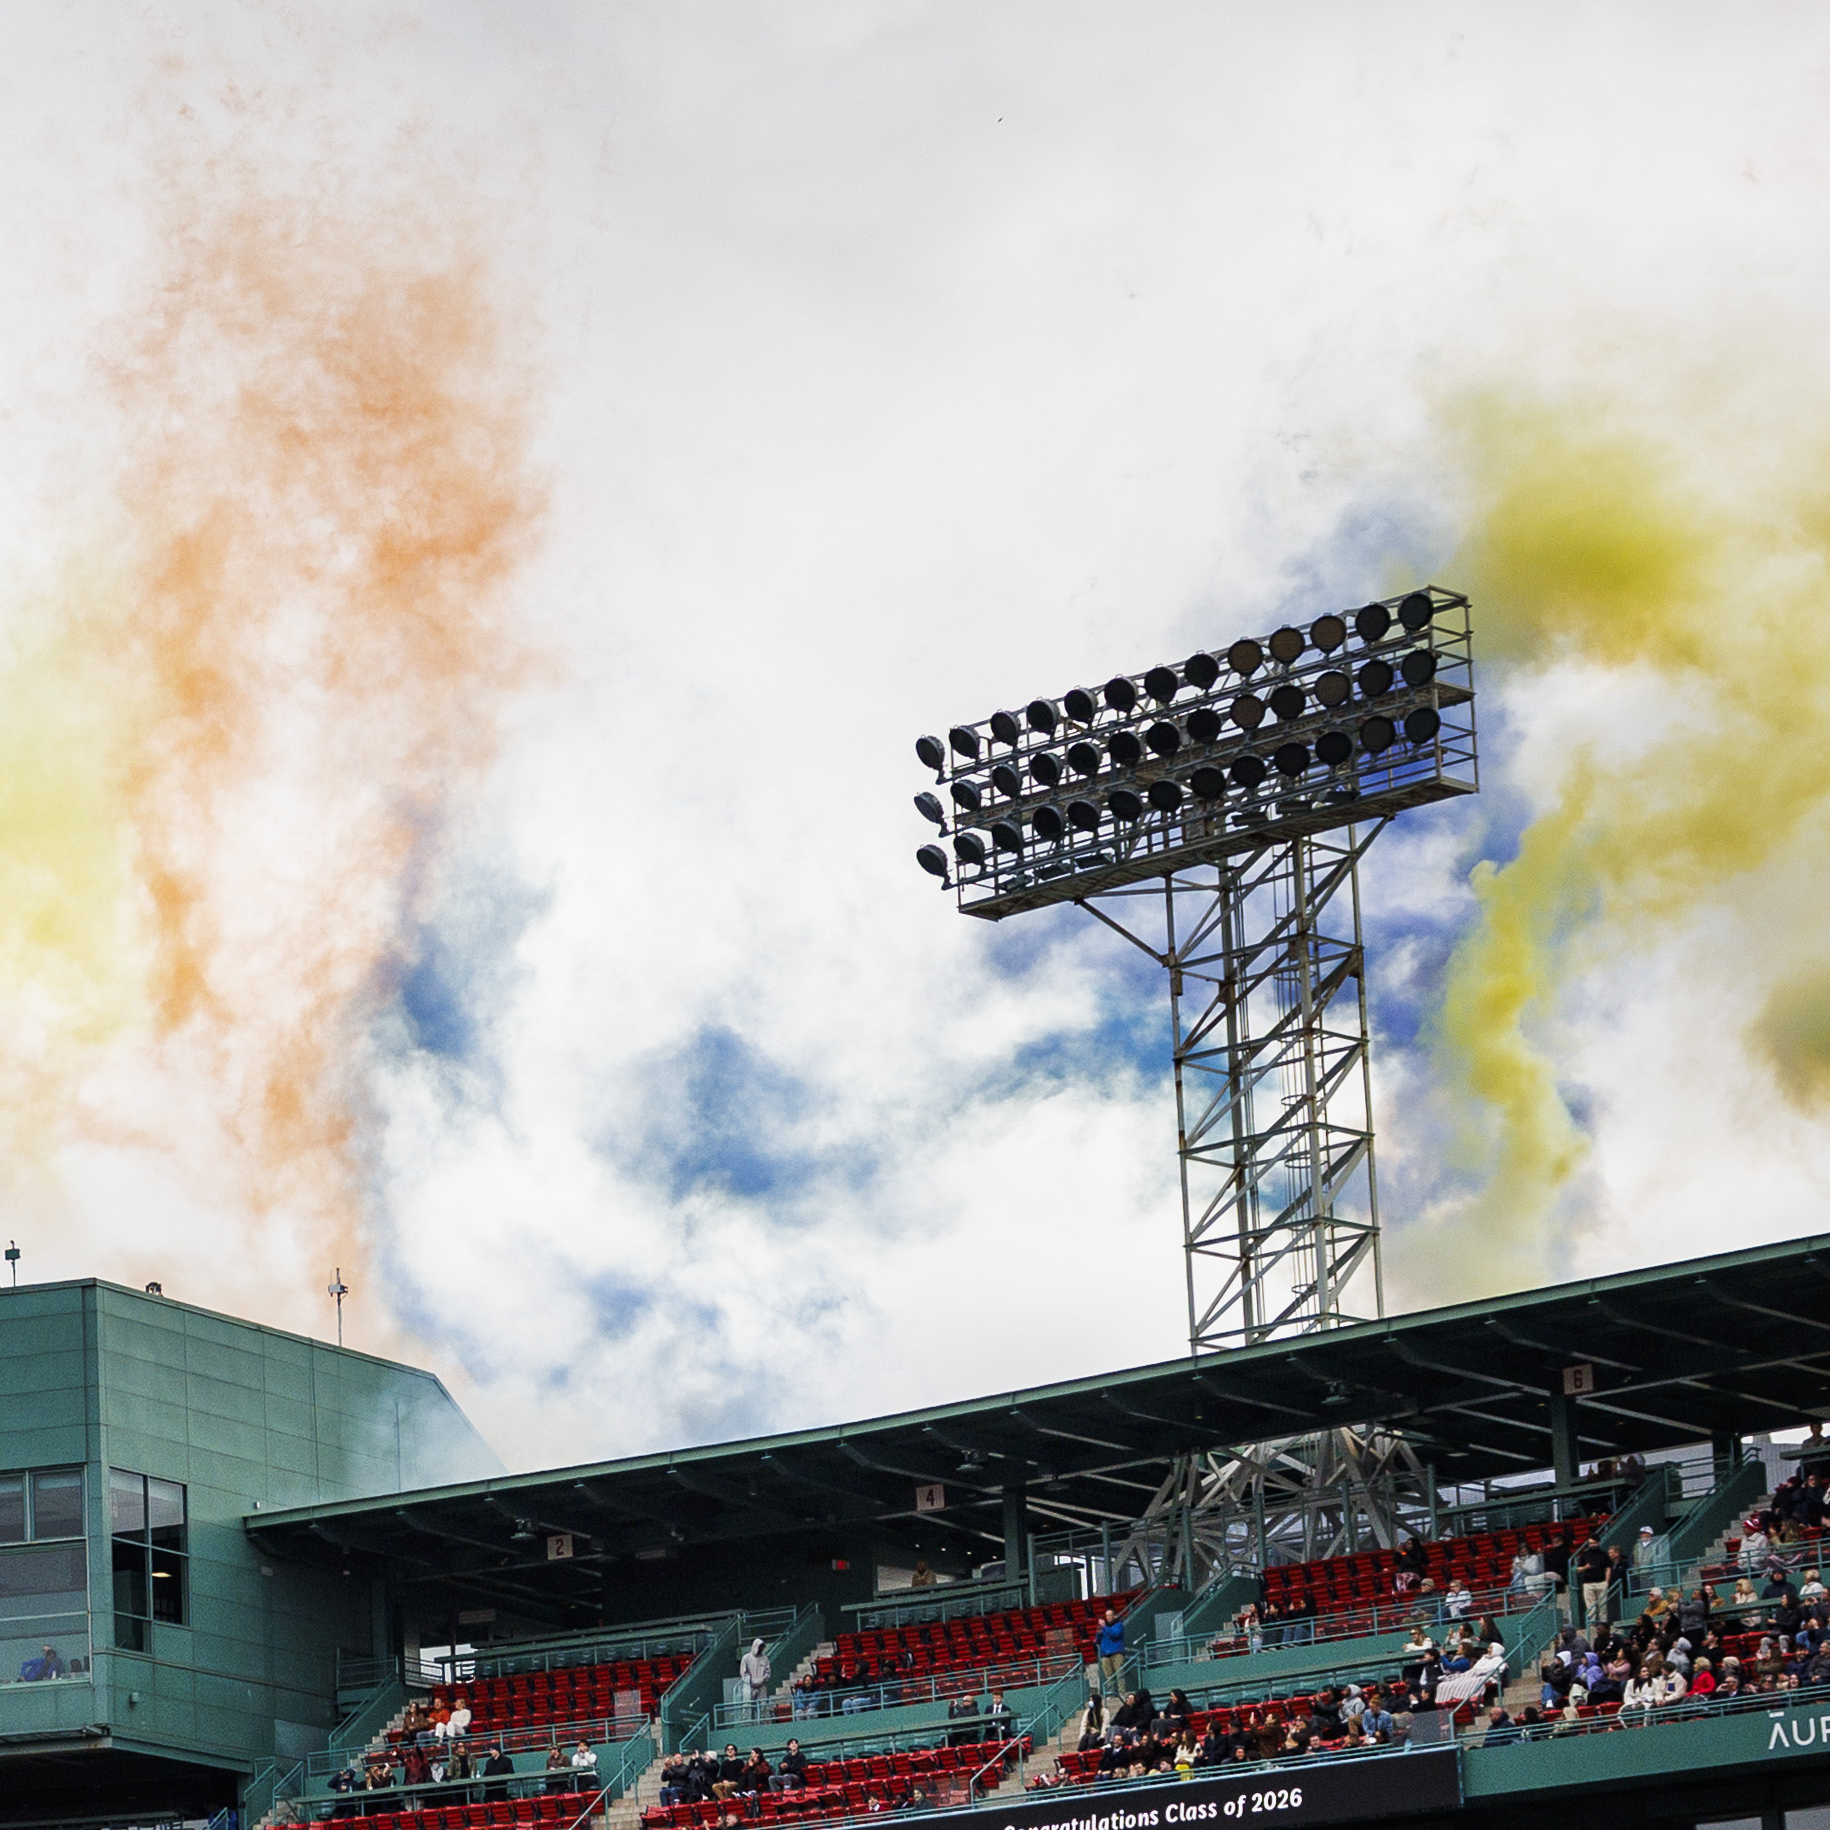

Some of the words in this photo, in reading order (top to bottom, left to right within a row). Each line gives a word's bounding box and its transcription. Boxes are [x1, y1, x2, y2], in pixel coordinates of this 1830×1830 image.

[1573, 1369, 1583, 1389] 6
[925, 1488, 936, 1507] 4
[555, 1538, 565, 1557] 2
[1166, 1801, 1218, 1823] Class
[1223, 1795, 1247, 1819] of
[1251, 1787, 1303, 1813] 2026
